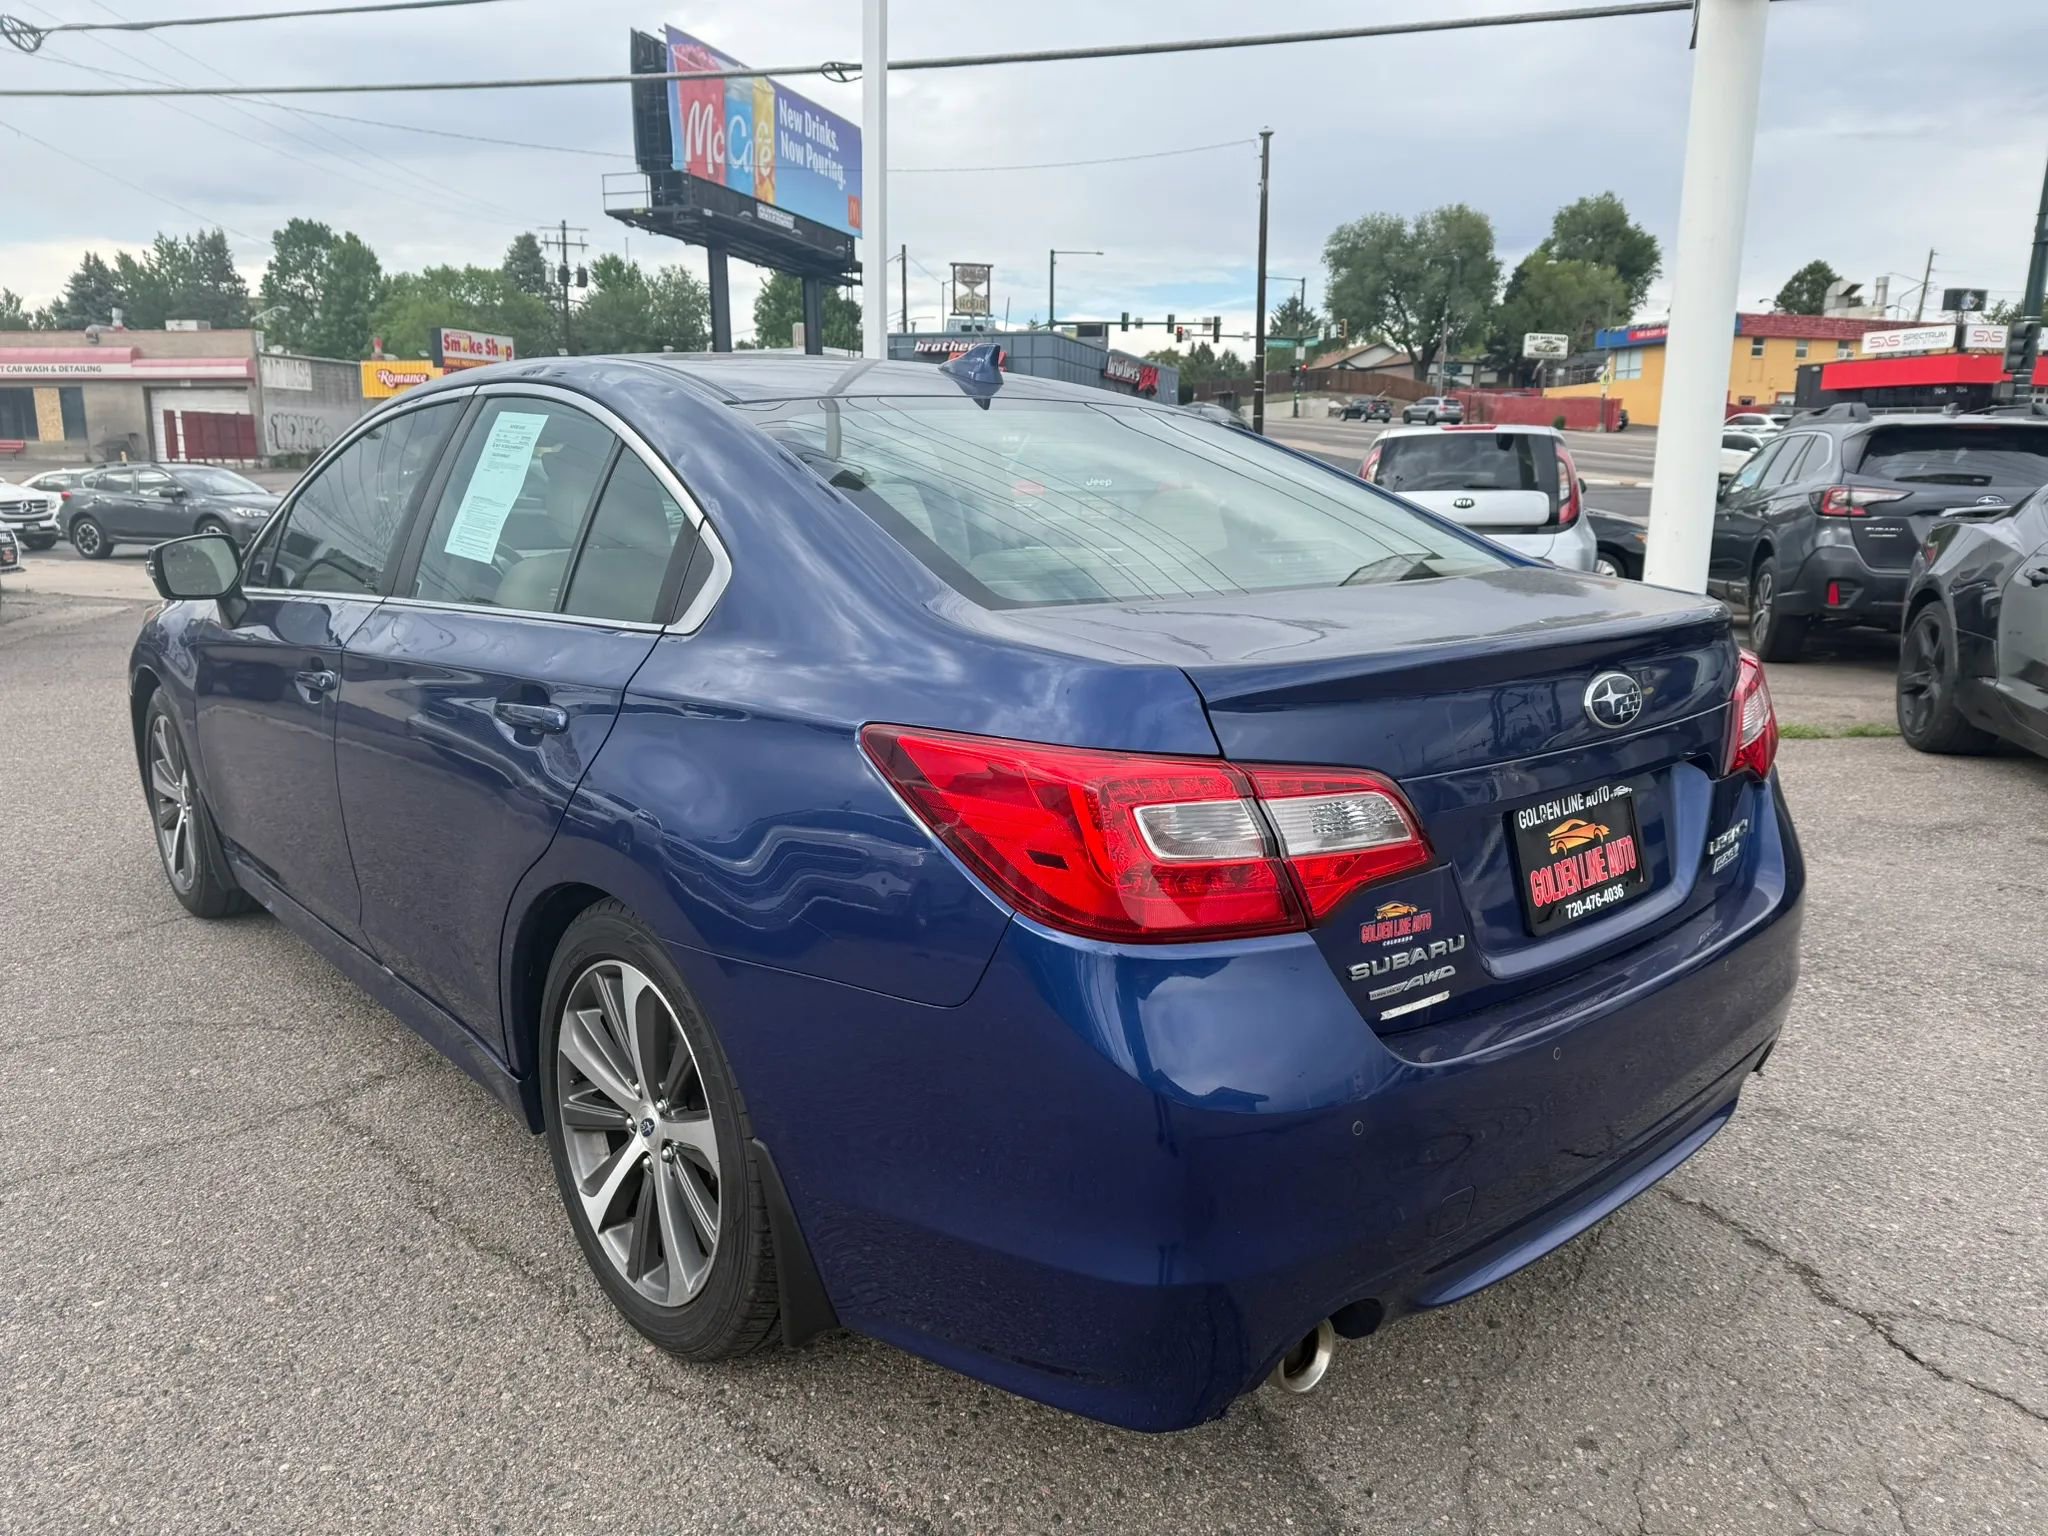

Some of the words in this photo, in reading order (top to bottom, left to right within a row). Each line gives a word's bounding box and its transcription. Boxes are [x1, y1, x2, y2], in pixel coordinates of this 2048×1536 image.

[779, 97, 802, 132] New
[804, 110, 839, 152] Drinks.
[780, 131, 803, 165] Now
[805, 143, 847, 191] Pouring.
[958, 299, 987, 311] HOUR
[443, 333, 483, 355] Smoke
[485, 337, 513, 361] Shop
[1903, 331, 1948, 341] SPECTRUM
[7, 365, 23, 373] CAR
[24, 365, 49, 373] WASH
[50, 365, 57, 373] &
[58, 365, 102, 373] DETAILING
[377, 369, 427, 388] Romance
[1086, 477, 1112, 487] Jeep
[1455, 499, 1473, 507] KIA
[1518, 801, 1560, 829] GOLDEN
[1562, 793, 1585, 816] LINE
[1586, 785, 1610, 808] AUTO
[1530, 855, 1582, 907] GOLDEN
[1579, 846, 1609, 889] LINE
[1606, 835, 1637, 878] AUTO
[1566, 883, 1625, 919] 720-476-4036
[1361, 920, 1394, 944] GOLDEN
[1394, 917, 1411, 937] LINE
[1412, 912, 1432, 933] AUTO
[1382, 935, 1413, 947] COLORADO
[1348, 934, 1465, 981] SUBARU
[1404, 965, 1456, 991] AWD
